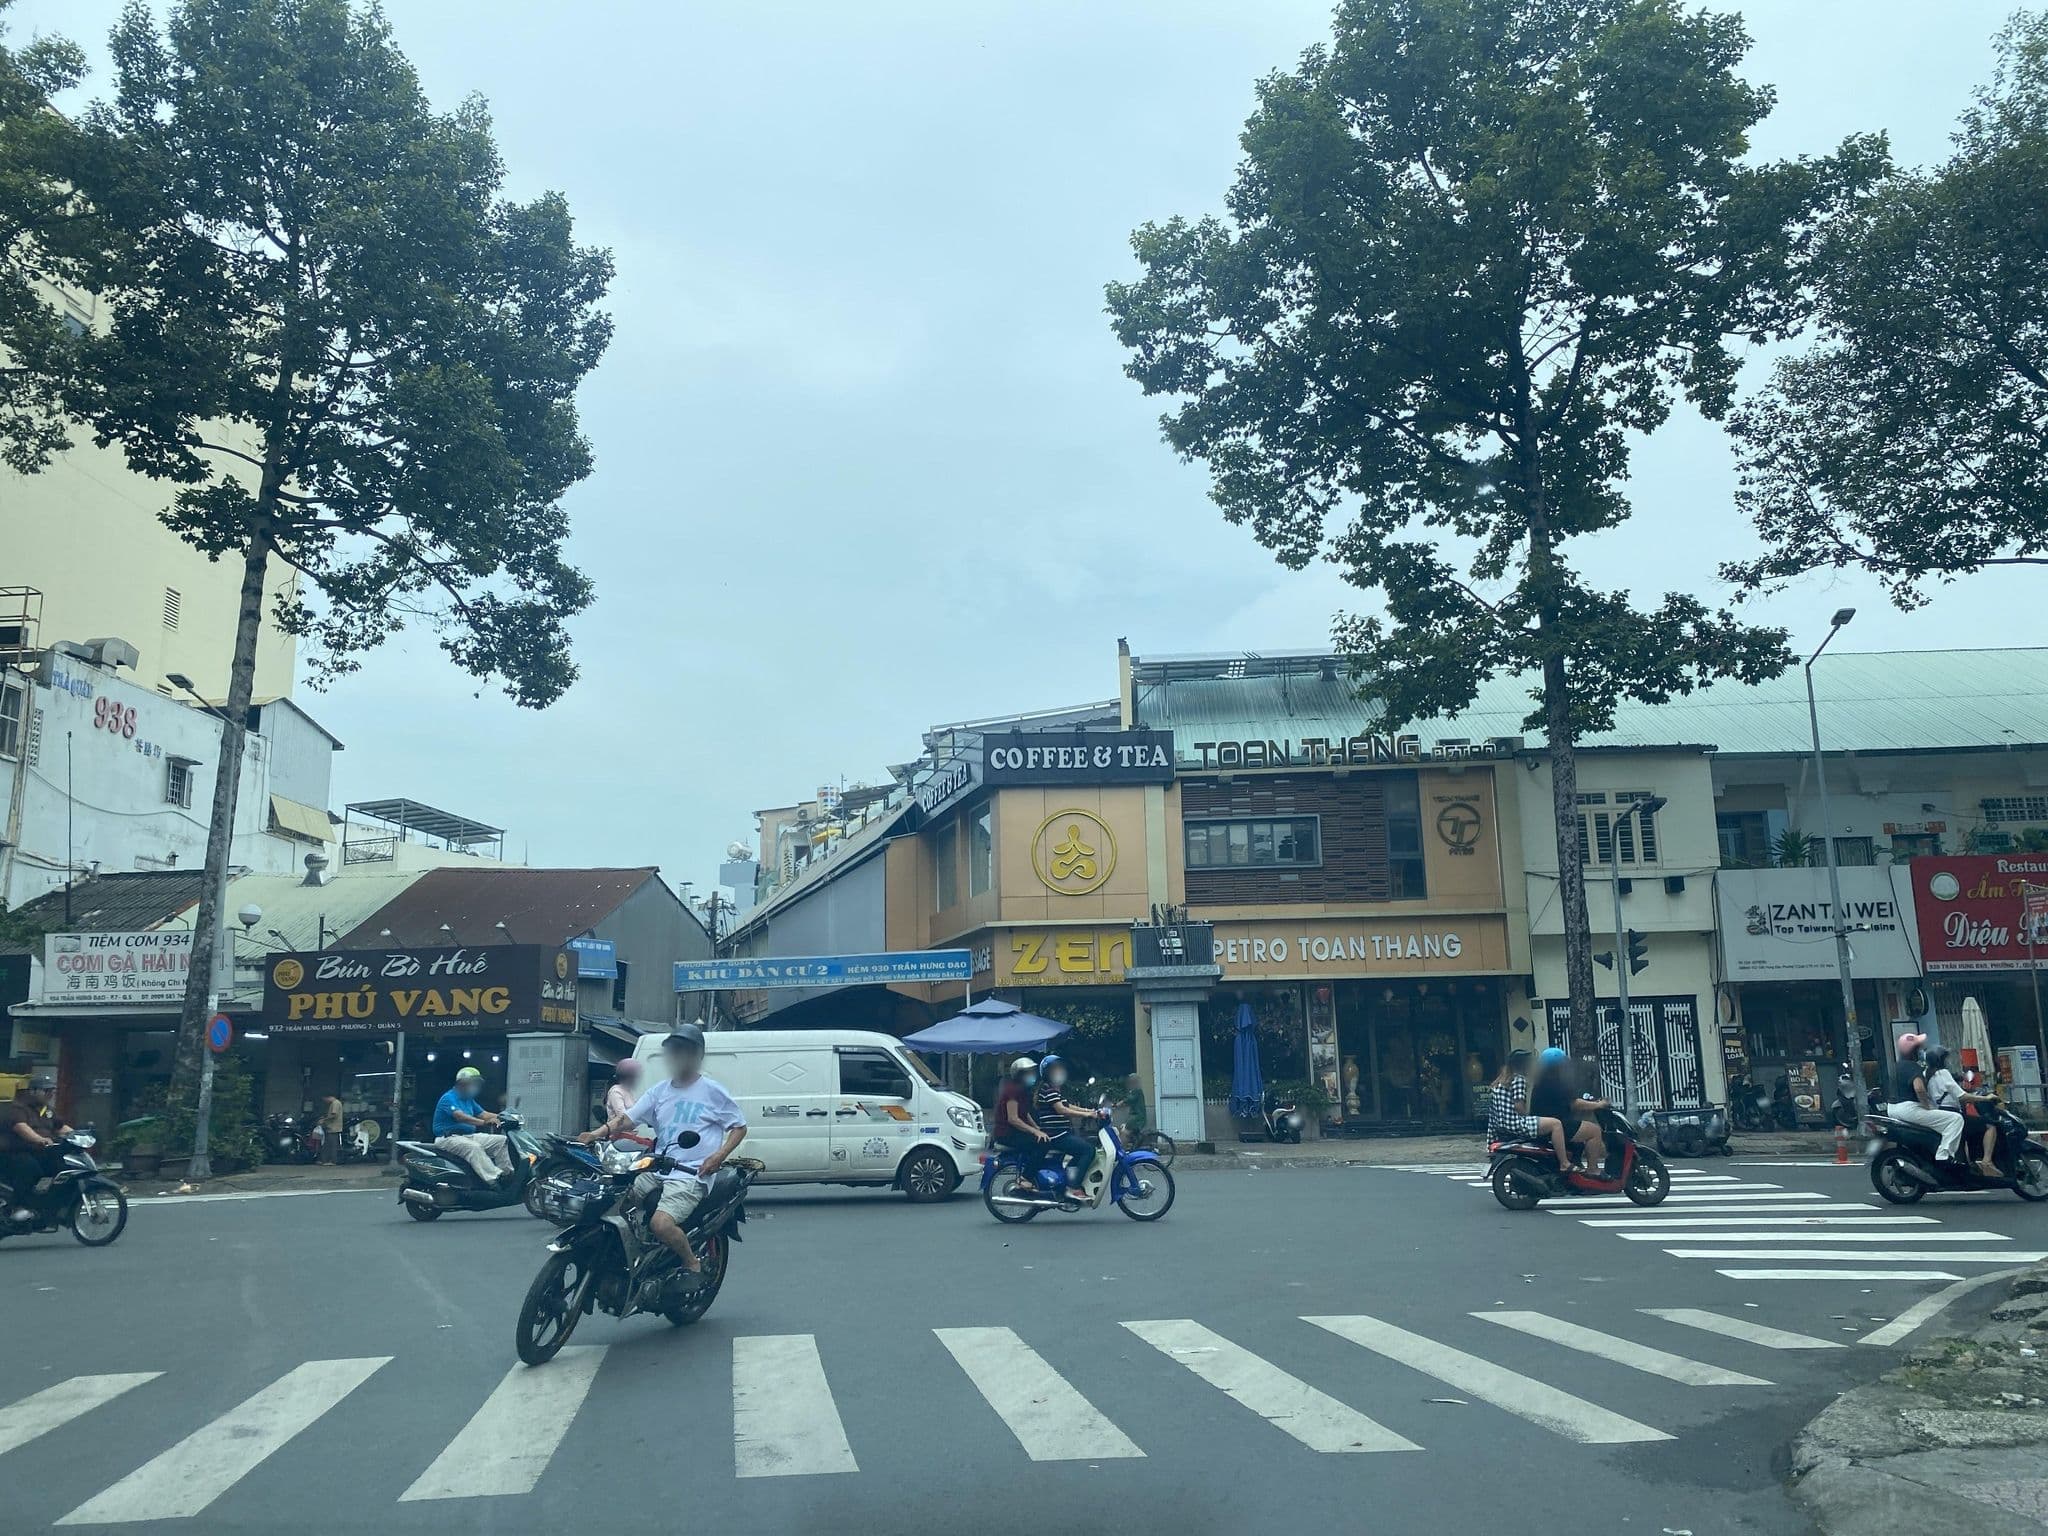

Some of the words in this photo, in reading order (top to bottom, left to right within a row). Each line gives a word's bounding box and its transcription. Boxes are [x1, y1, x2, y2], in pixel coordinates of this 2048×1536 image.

[94, 696, 137, 739] 938
[990, 747, 1088, 769] COFFEE
[1093, 746, 1112, 768] &
[1117, 745, 1169, 767] TEA
[1193, 739, 1291, 770] TOAN
[1301, 734, 1421, 768] THANG
[922, 778, 946, 813] COFFEE
[1996, 859, 2048, 873] Restau
[1775, 924, 1794, 934] Top
[1856, 923, 1896, 931] Cisine
[1944, 911, 2010, 954] Diệu
[88, 934, 123, 949] TIỆM
[125, 934, 159, 947] CƠM
[162, 934, 190, 946] 934
[1213, 937, 1289, 963] PETRO
[1297, 935, 1366, 962] TOAN
[1370, 932, 1463, 960] THANG
[56, 952, 104, 974] CƠM
[108, 950, 137, 974] GÀ
[141, 947, 176, 973] HẢI
[315, 955, 372, 980] Bún
[381, 954, 421, 977] Bò
[429, 949, 488, 976] Huế
[687, 968, 732, 980] KHU
[738, 964, 779, 978] DÂN
[785, 964, 813, 977] CƯ
[816, 965, 828, 976] 2
[871, 963, 889, 972] 930
[892, 960, 917, 971] TRẦN
[919, 961, 945, 969] HƯNG
[947, 961, 967, 969] ĐẠO
[66, 974, 136, 989] 海南鸡饭
[287, 983, 378, 1020] PHÚ
[389, 986, 512, 1017] VANG
[269, 1024, 283, 1032] 932
